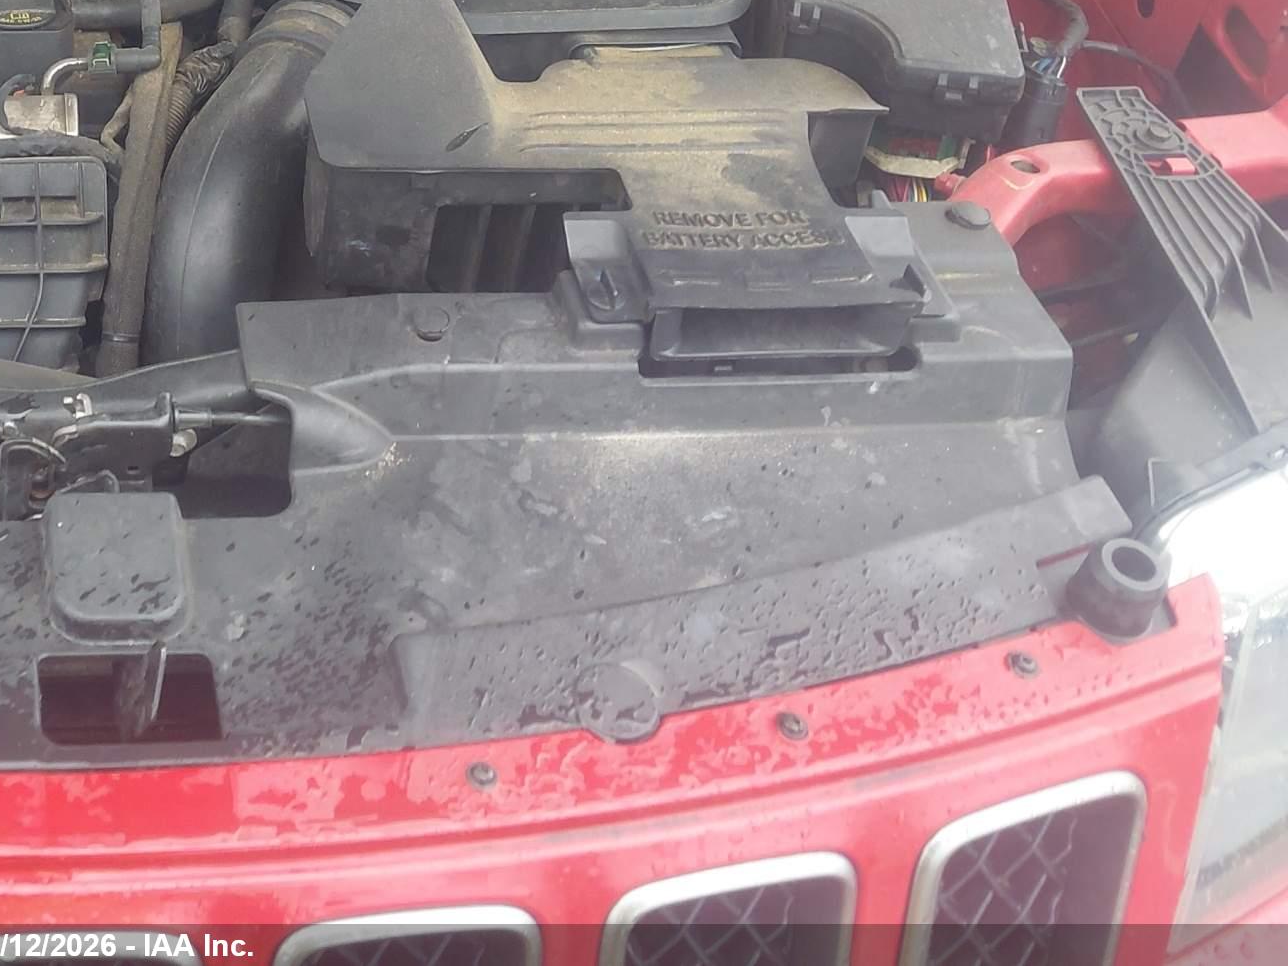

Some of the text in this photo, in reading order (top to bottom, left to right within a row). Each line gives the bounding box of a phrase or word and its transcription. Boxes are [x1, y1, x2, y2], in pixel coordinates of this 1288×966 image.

[653, 210, 807, 227] REMOVE FOR
[642, 232, 742, 249] BATTERY
